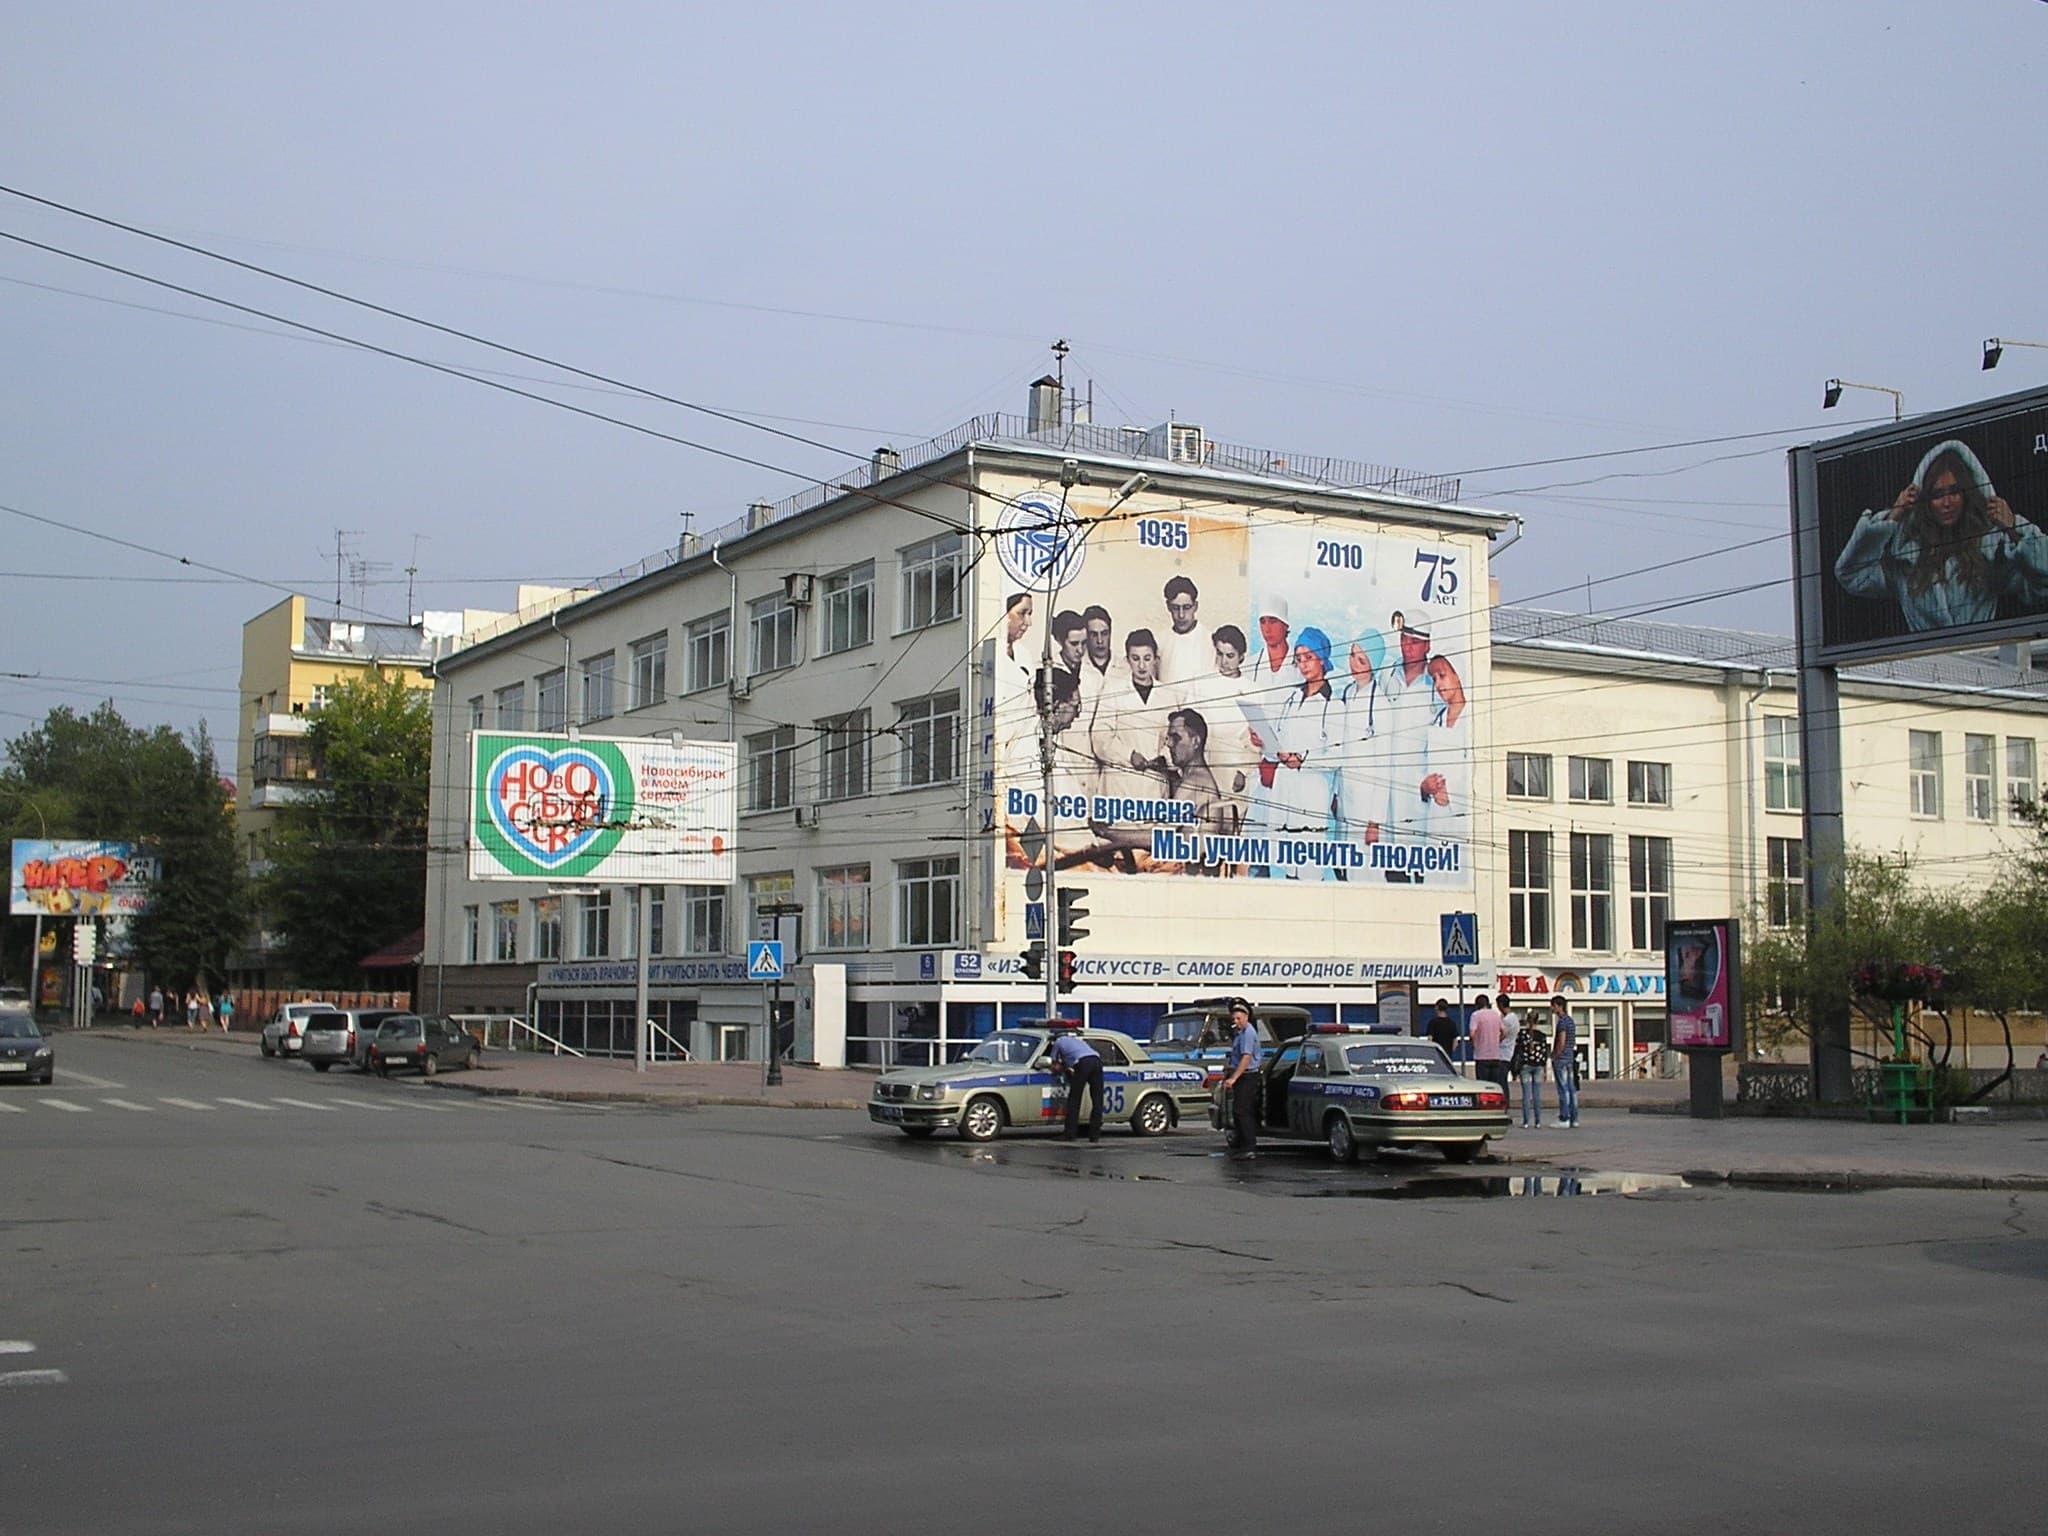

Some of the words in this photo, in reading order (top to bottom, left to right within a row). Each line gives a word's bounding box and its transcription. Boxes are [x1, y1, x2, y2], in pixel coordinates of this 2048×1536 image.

[1137, 519, 1188, 549] 1935
[1317, 541, 1362, 570] 2010
[1414, 548, 1458, 602] 75
[641, 765, 726, 780] Новосибирск
[641, 780, 649, 788] в
[641, 790, 687, 802] сердце
[1008, 788, 1038, 816] Во
[1094, 797, 1198, 826] времена,
[1154, 829, 1199, 860] Мы
[1205, 836, 1269, 864] учим
[1277, 840, 1363, 867] лечить
[1371, 840, 1459, 874] людей!
[960, 955, 977, 967] 52
[987, 959, 1021, 975] «ИЗ
[1177, 962, 1235, 976] САМОЕ
[1241, 962, 1354, 978] БЛАГОРОДНОЕ
[1361, 964, 1453, 979] МЕДИЦИНА»
[1178, 1071, 1200, 1080] ЧАСТЬ
